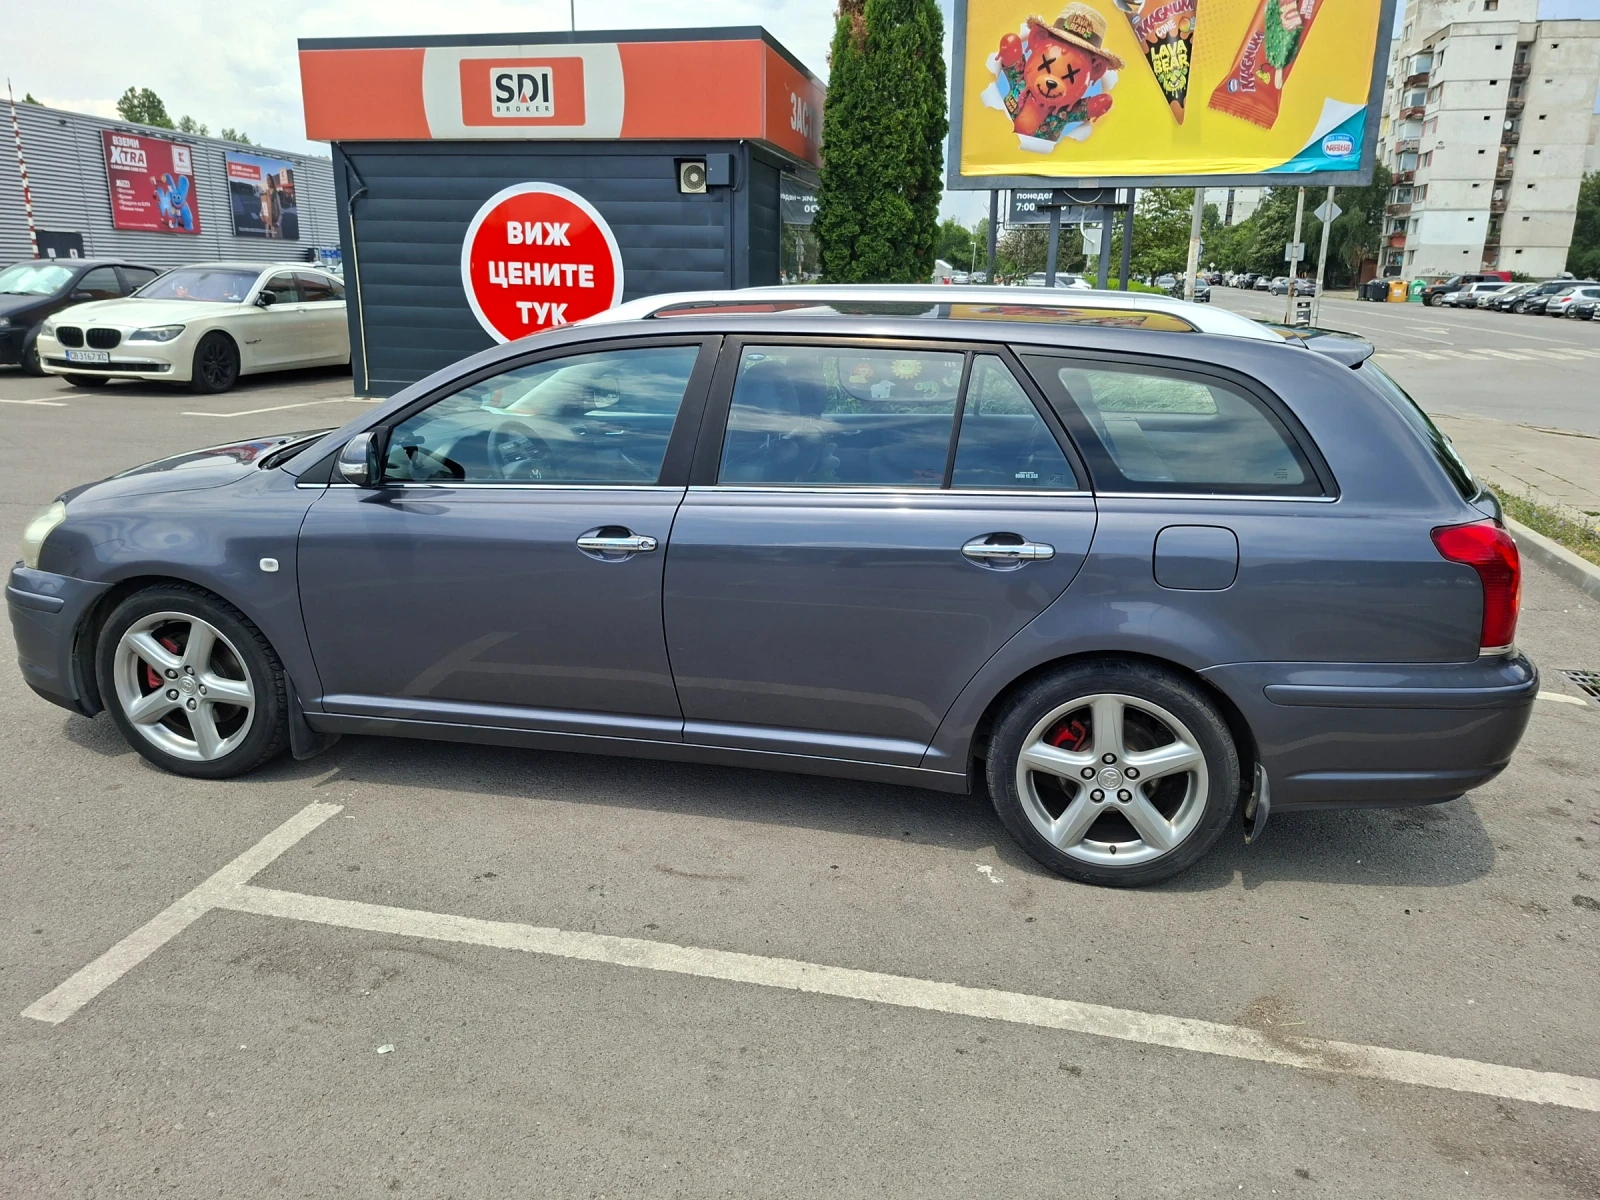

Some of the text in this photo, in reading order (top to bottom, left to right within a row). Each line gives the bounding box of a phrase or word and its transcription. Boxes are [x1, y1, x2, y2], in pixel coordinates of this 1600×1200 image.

[1070, 22, 1086, 34] BEAR
[1072, 15, 1089, 28] LAVA
[1135, 0, 1195, 42] MAGNUM
[1156, 20, 1177, 37] CONE
[1150, 39, 1188, 62] LAVA
[1240, 29, 1265, 92] MAGNUM
[1153, 54, 1190, 76] BEAR
[495, 73, 549, 103] SDI
[112, 135, 140, 149] ВЗЕМИ
[1016, 203, 1035, 212] 7:00
[507, 221, 571, 246] ВИЖ
[488, 261, 595, 289] ЦЕНИТЕ
[516, 301, 568, 326] ТУК
[80, 352, 95, 361] 3167
